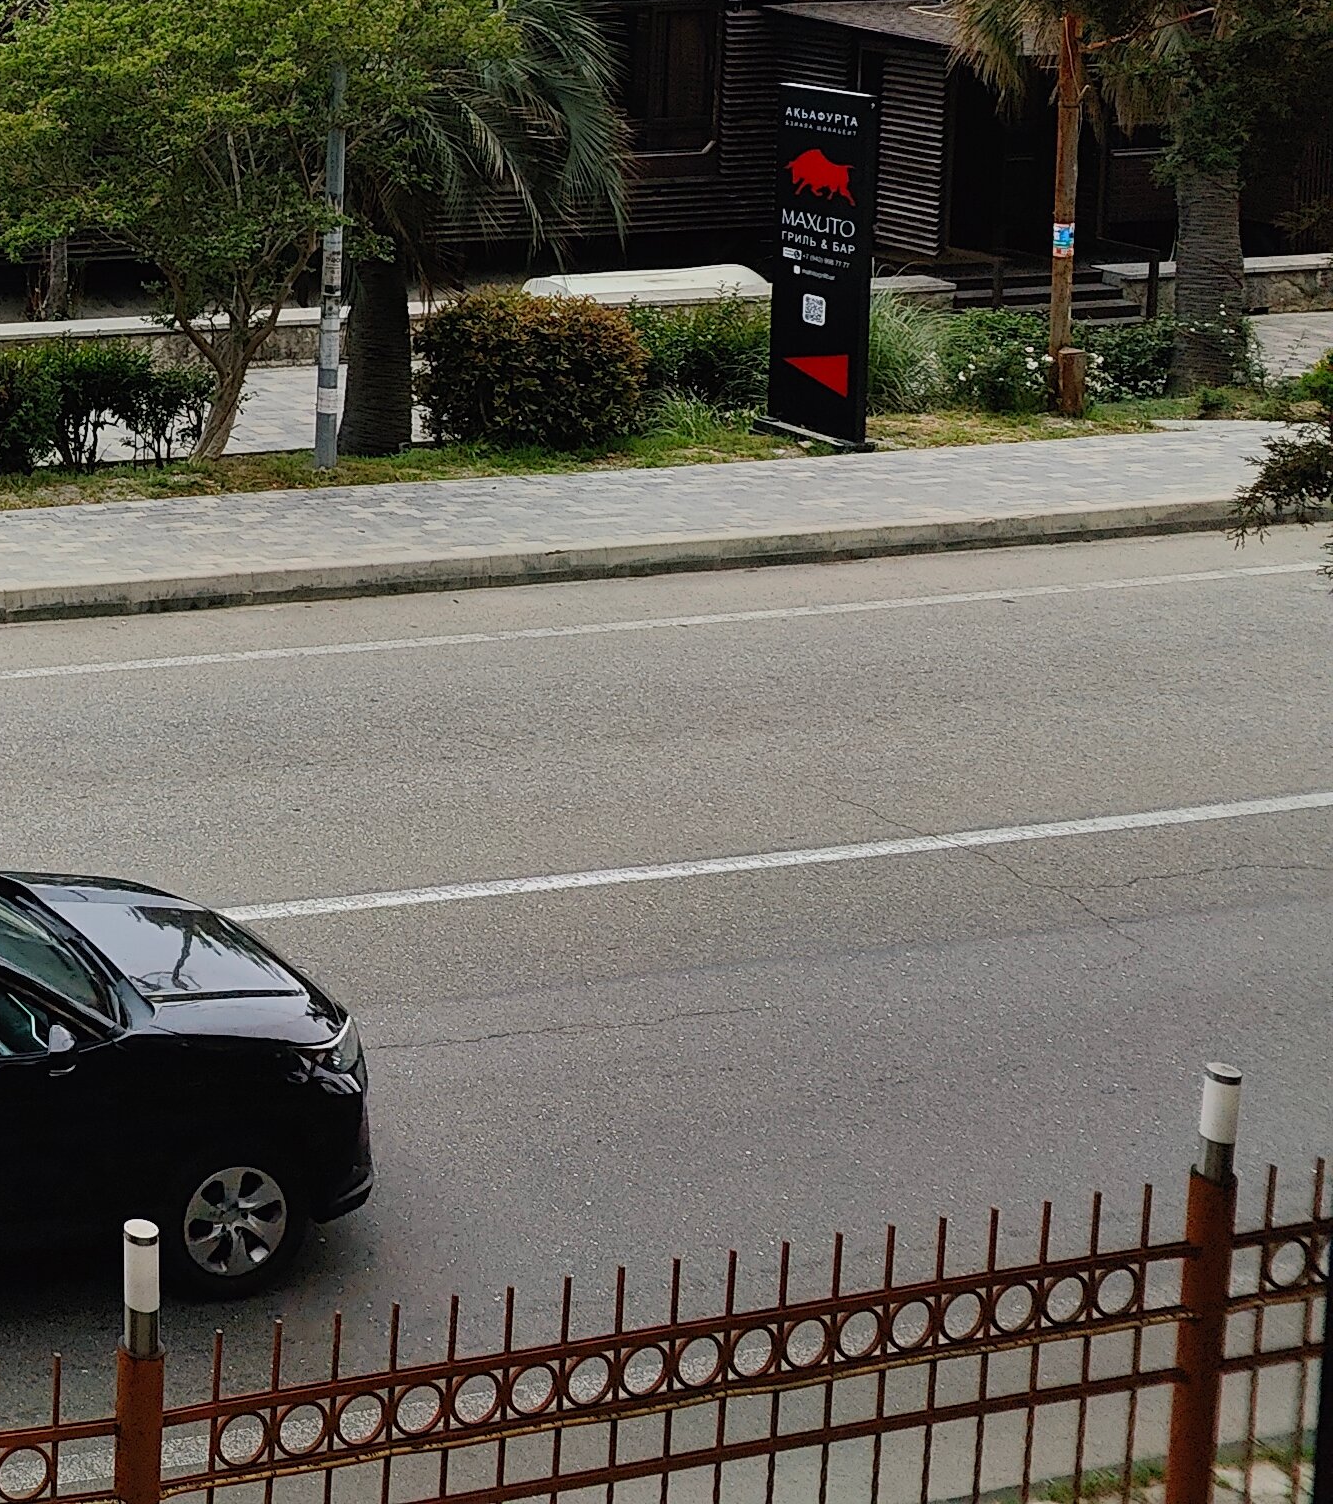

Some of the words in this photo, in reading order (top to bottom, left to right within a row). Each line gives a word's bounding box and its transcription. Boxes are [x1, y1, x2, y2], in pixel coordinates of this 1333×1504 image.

[781, 230, 817, 247] ГРИЛЬ
[820, 238, 828, 250] &
[832, 241, 856, 254] БАР
